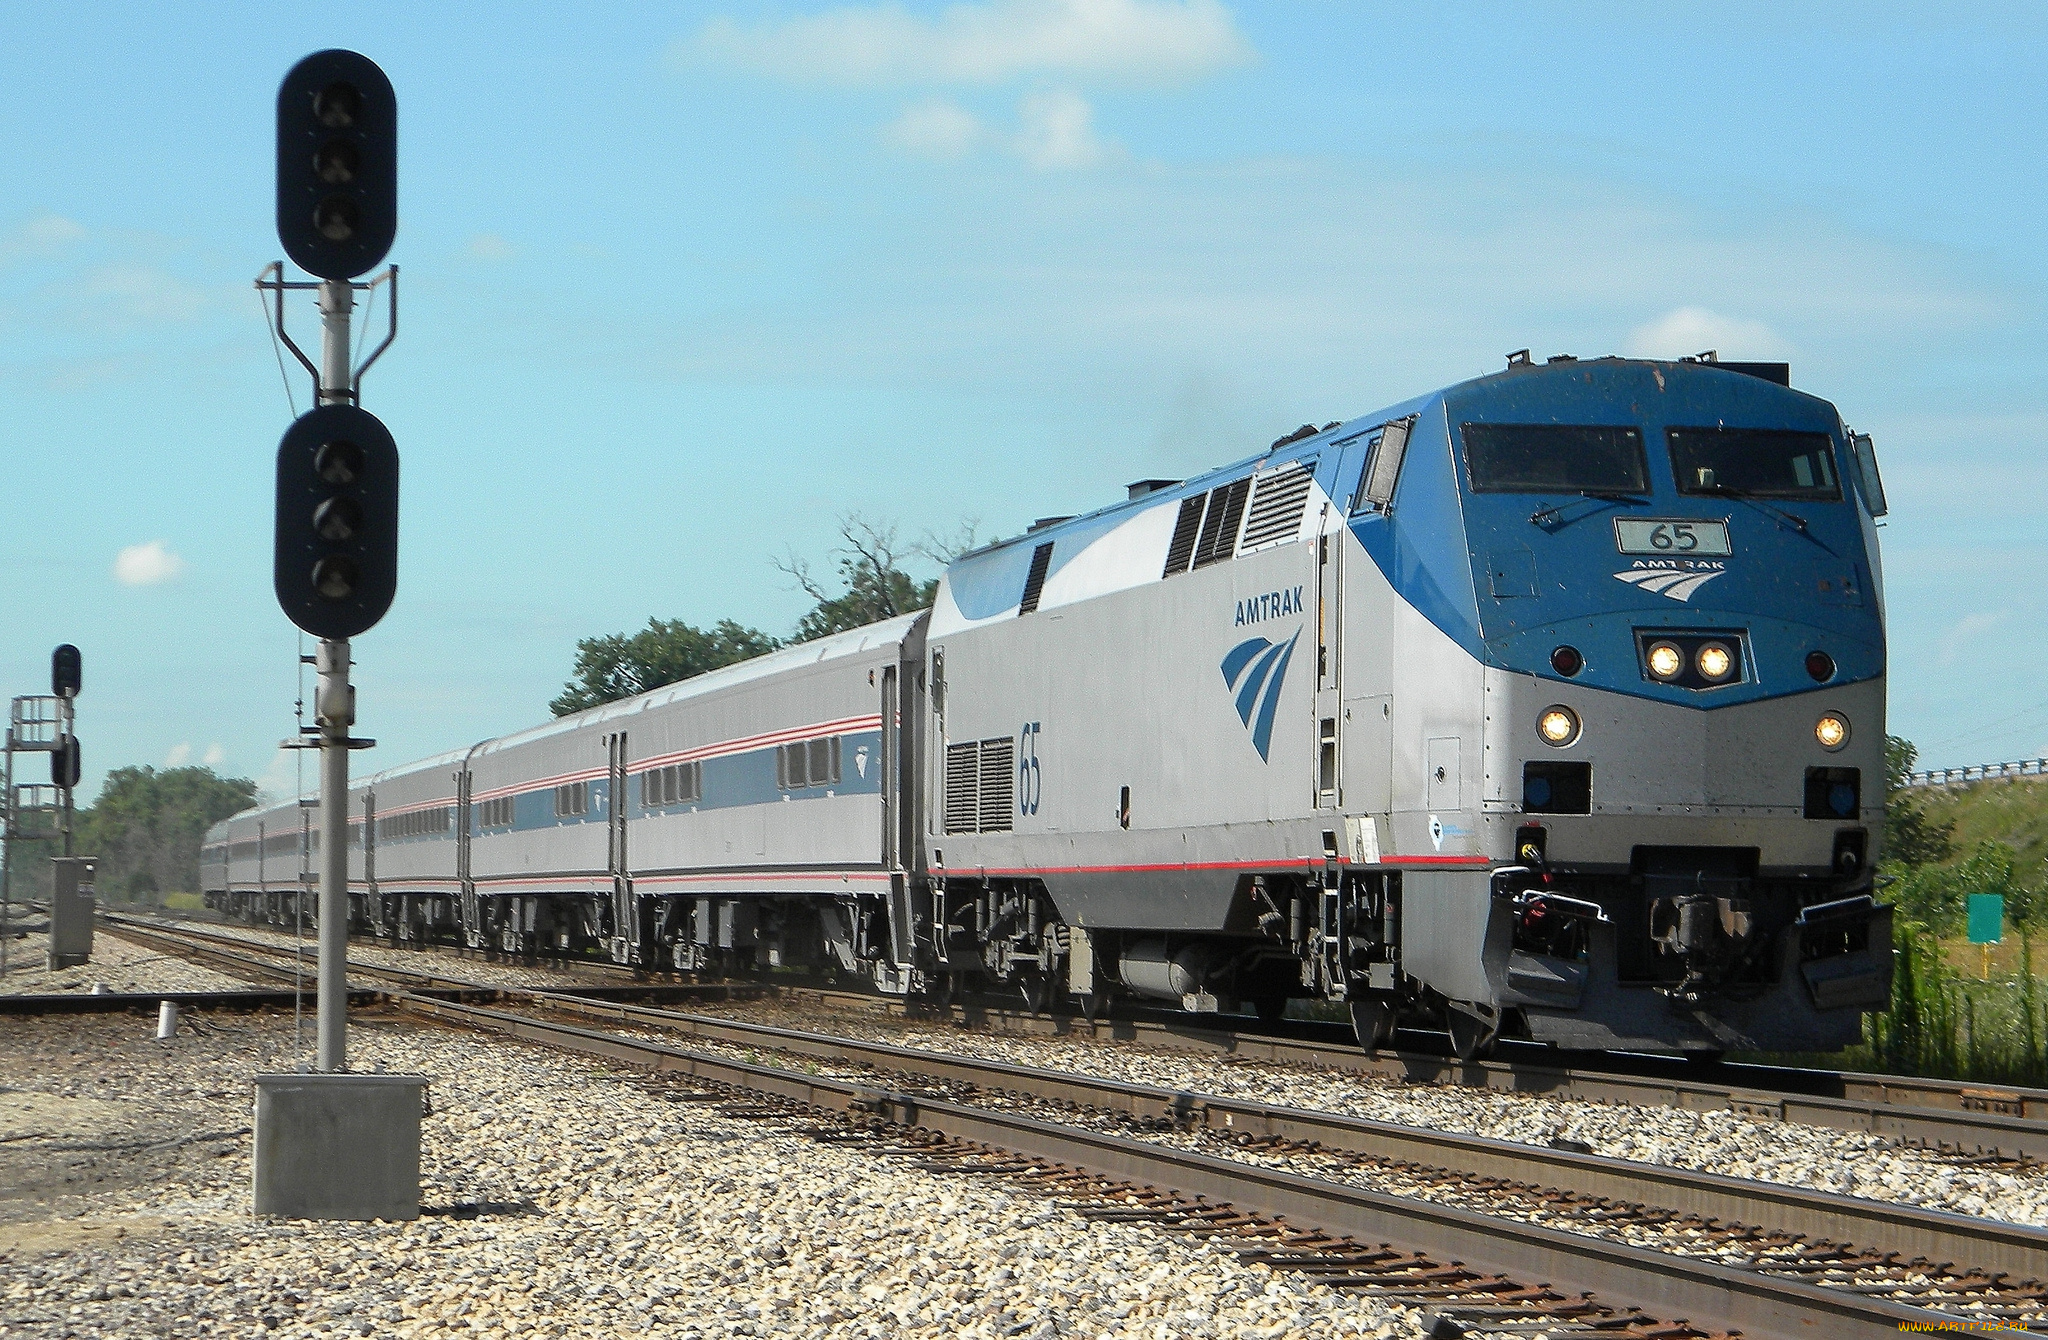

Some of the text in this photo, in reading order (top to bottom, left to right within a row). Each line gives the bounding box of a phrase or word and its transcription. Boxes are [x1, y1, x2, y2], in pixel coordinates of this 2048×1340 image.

[1650, 523, 1698, 550] 65
[1234, 585, 1304, 627] AMTRAK
[1020, 721, 1041, 816] 65
